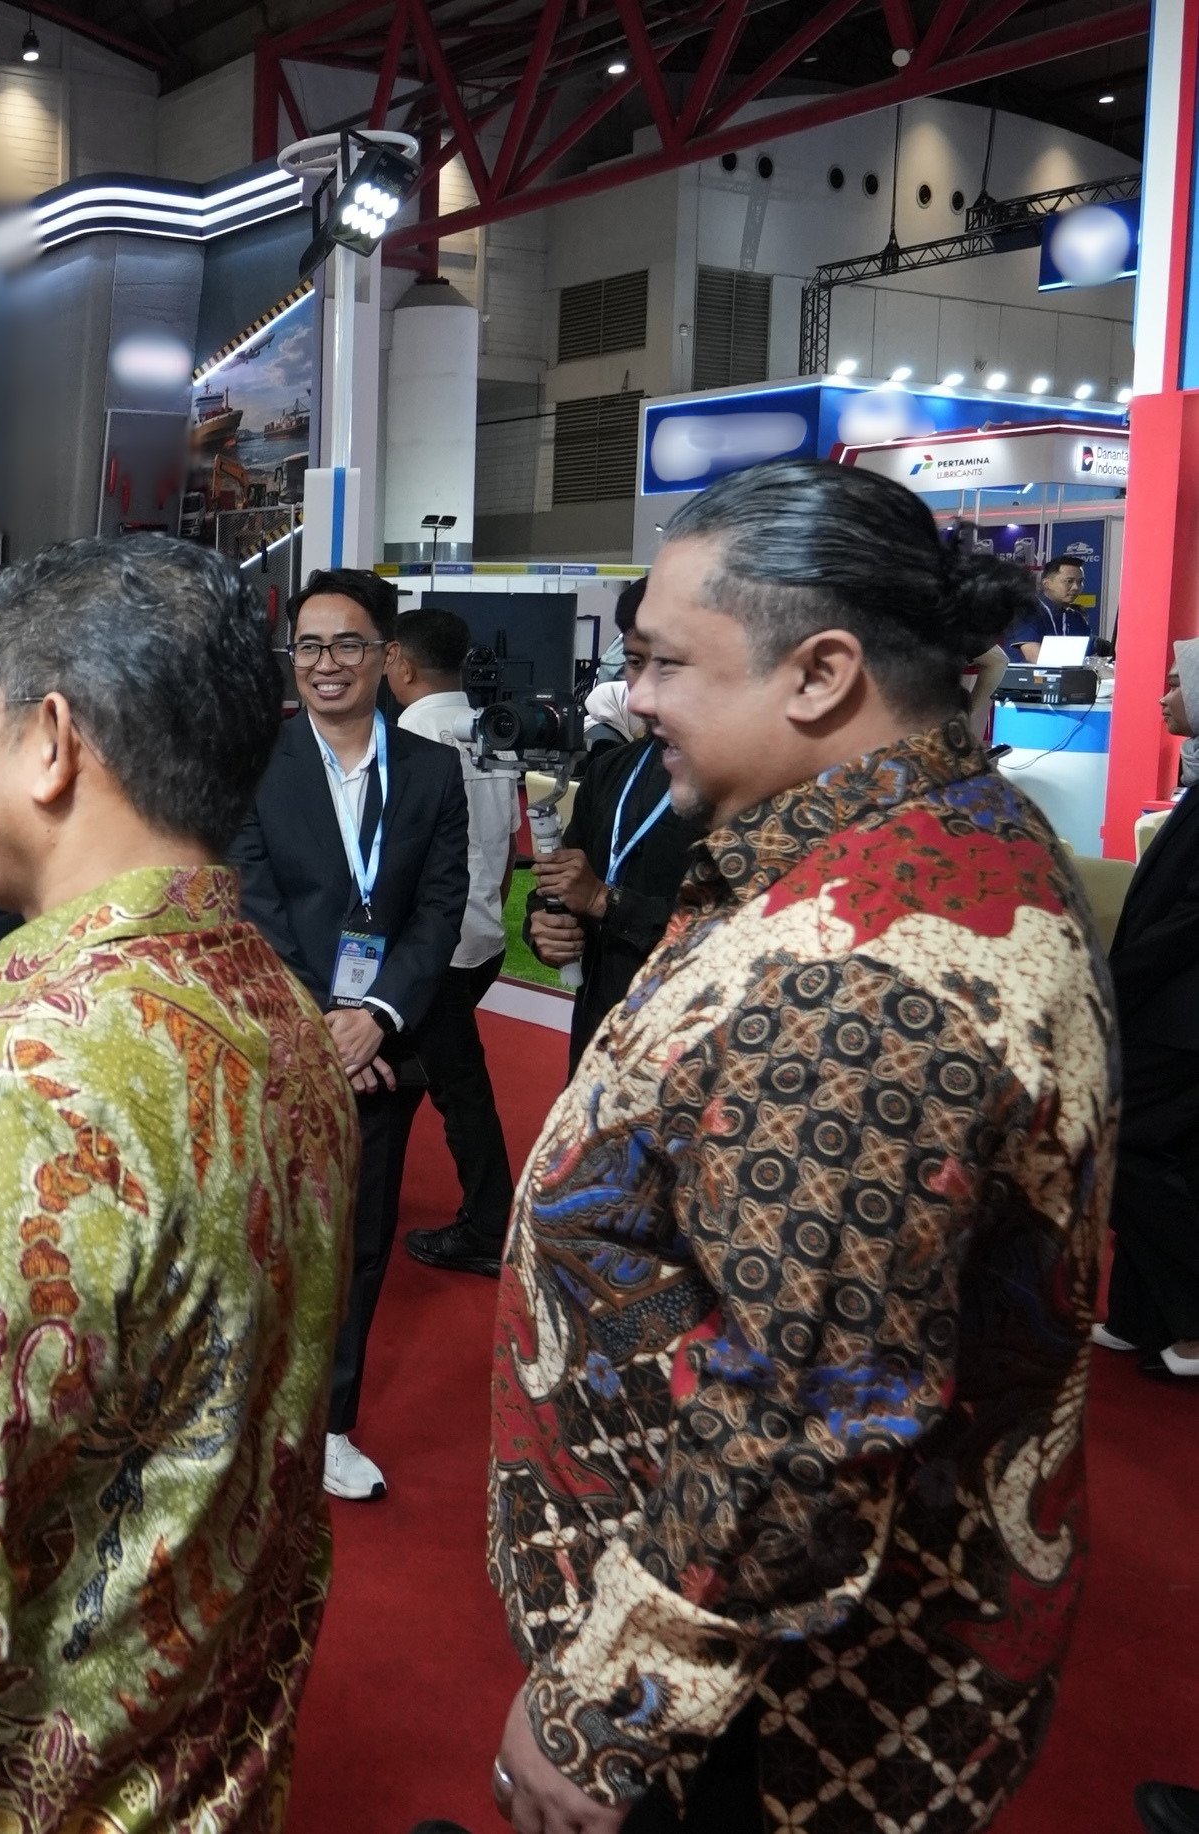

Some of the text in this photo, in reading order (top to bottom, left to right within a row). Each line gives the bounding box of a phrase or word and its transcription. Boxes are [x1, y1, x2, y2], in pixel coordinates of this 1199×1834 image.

[1096, 446, 1129, 461] Dananta
[937, 457, 990, 468] PERTAMINA
[1095, 461, 1128, 475] Indones
[936, 467, 983, 479] LUBRICANTS
